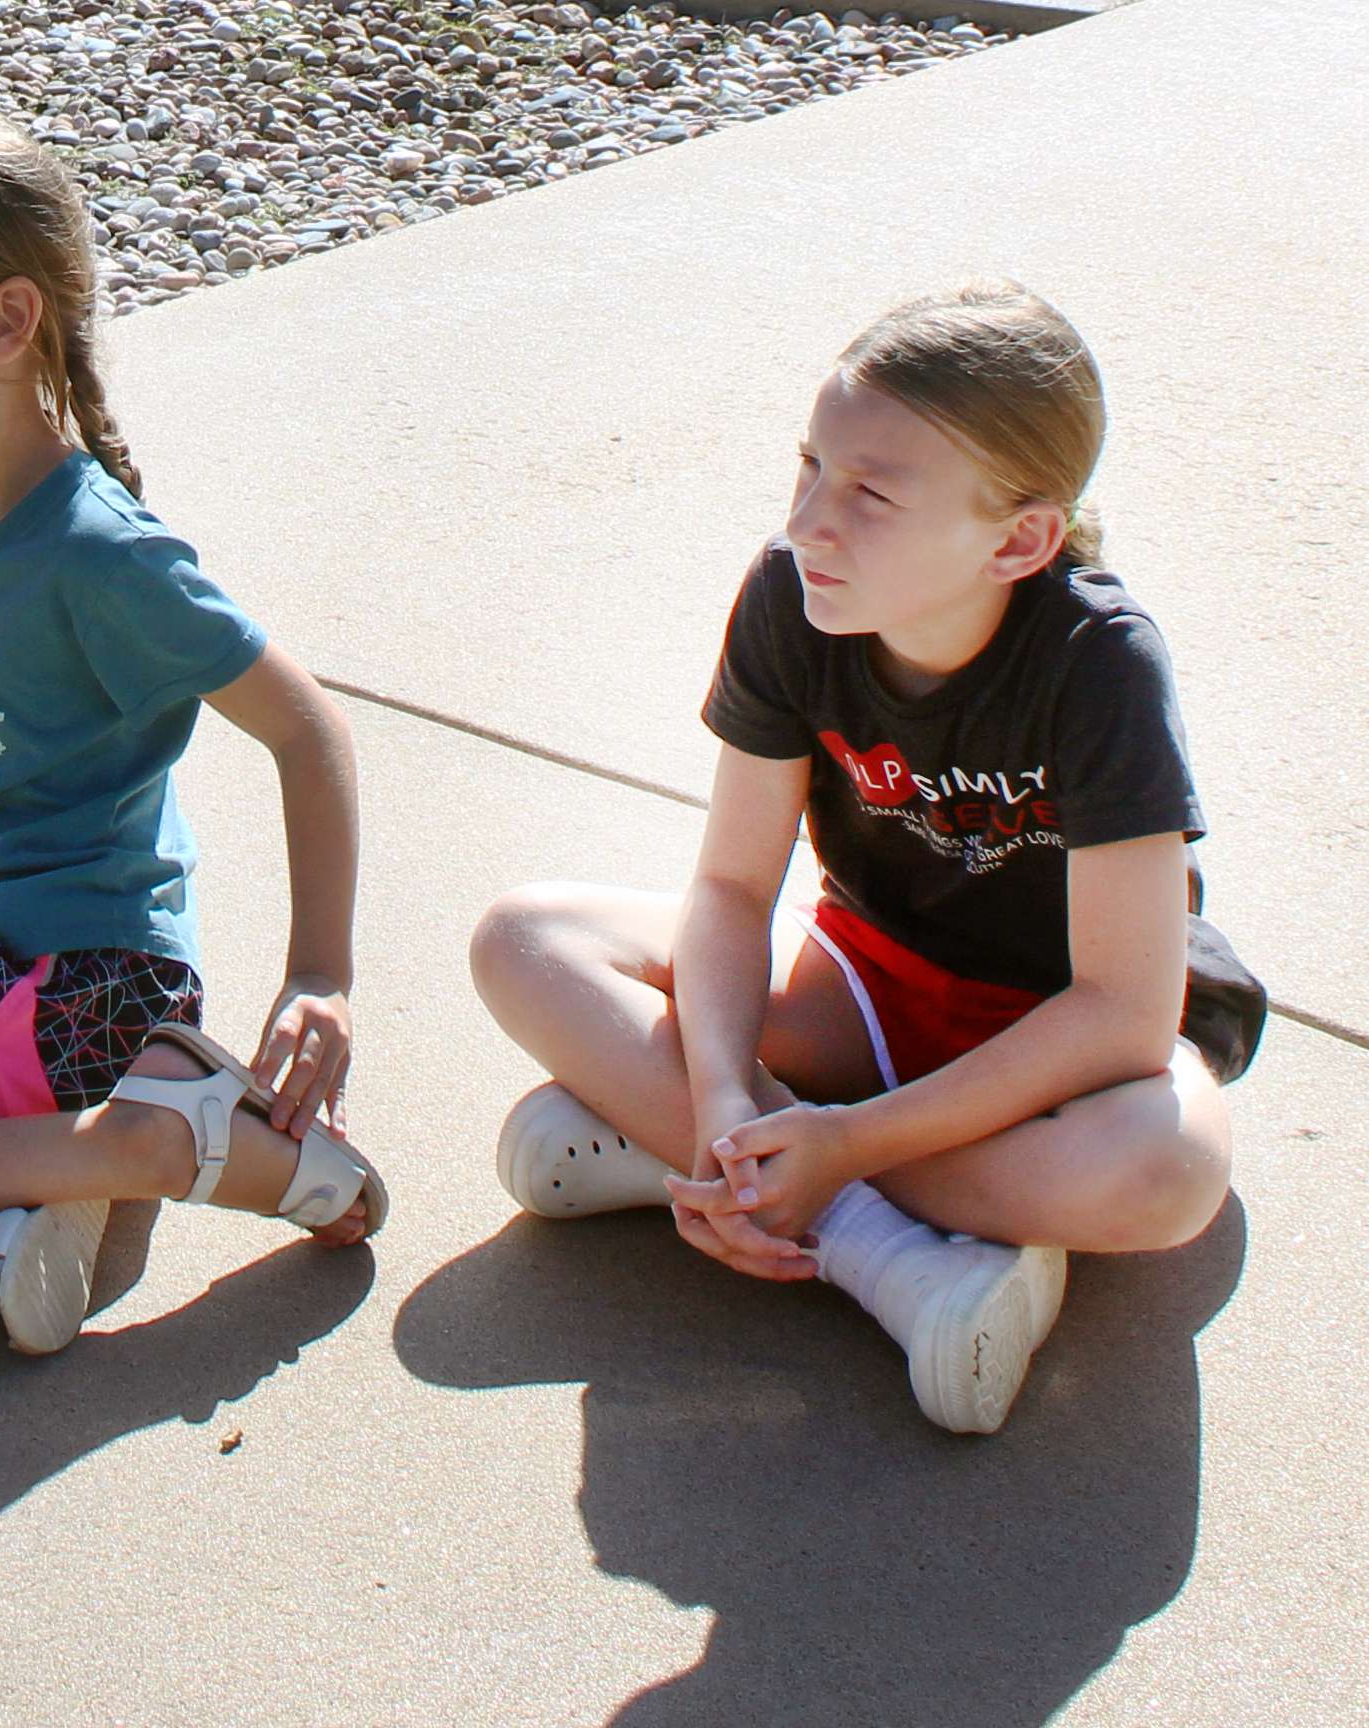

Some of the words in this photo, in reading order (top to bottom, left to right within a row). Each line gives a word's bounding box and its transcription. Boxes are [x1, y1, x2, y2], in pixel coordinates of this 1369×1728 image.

[911, 765, 1046, 804] SIMLY
[867, 805, 920, 824] SMALL
[976, 835, 1024, 863] GREAT
[1026, 830, 1065, 850] LOVE
